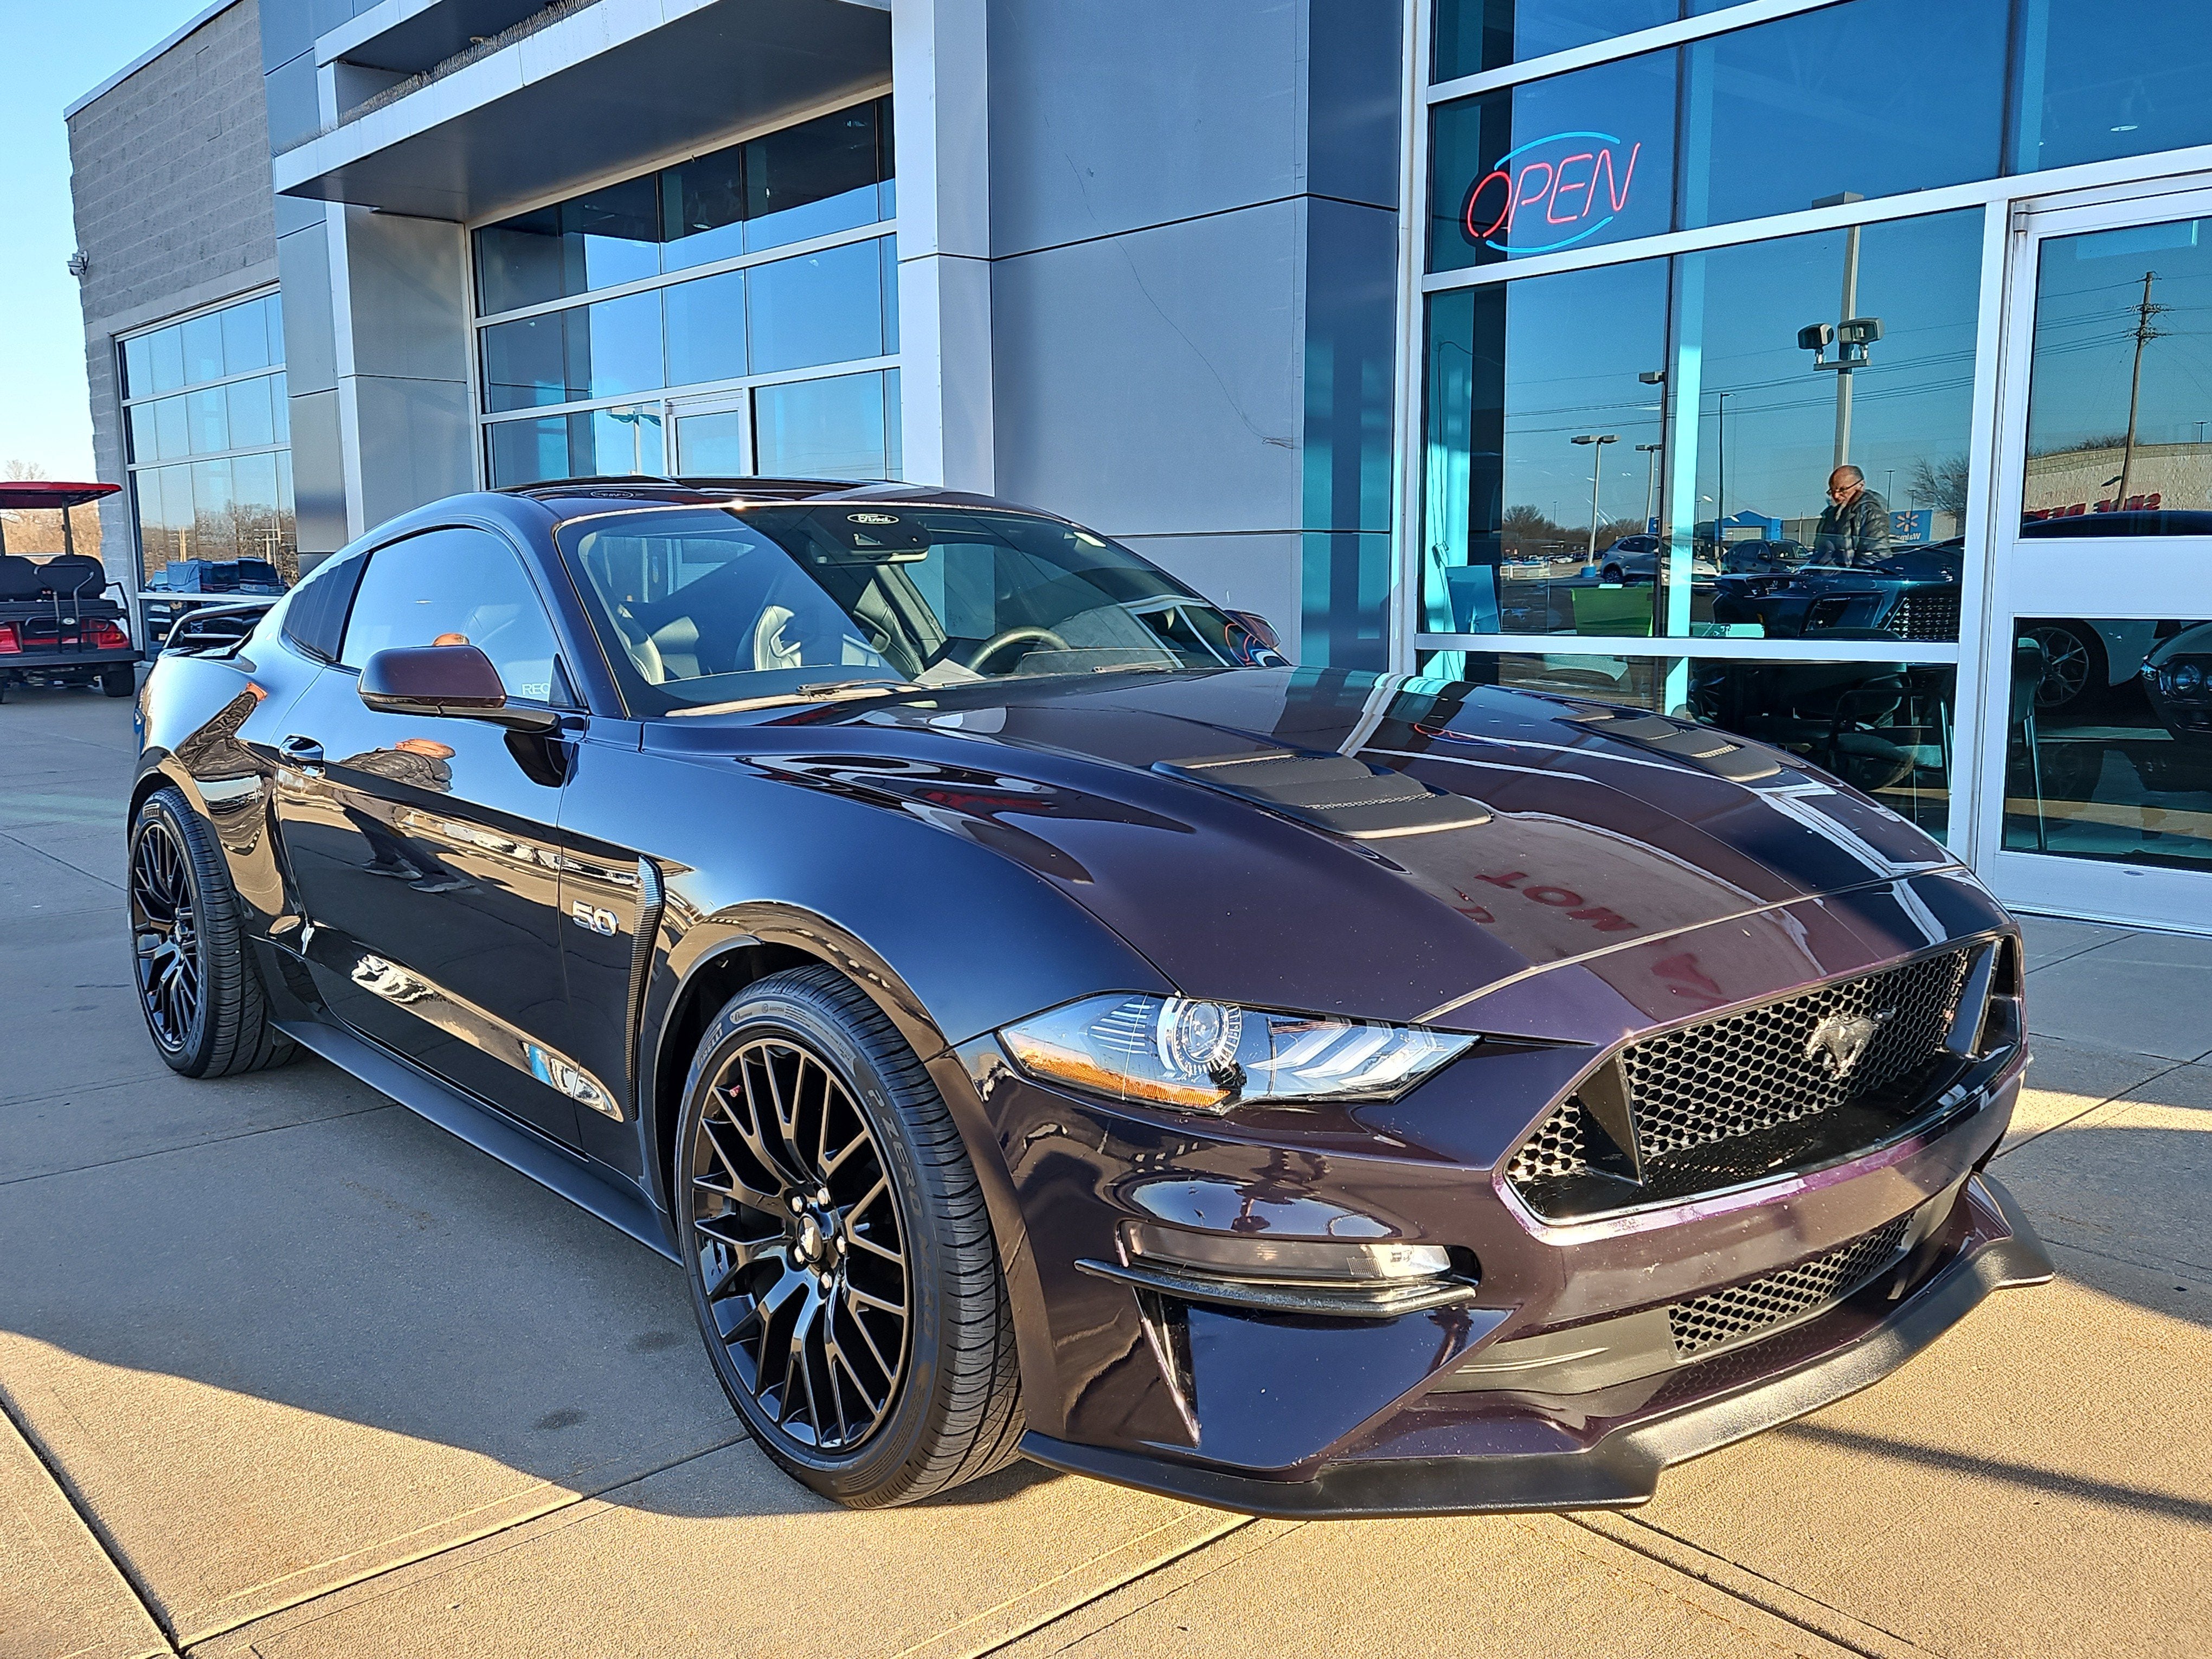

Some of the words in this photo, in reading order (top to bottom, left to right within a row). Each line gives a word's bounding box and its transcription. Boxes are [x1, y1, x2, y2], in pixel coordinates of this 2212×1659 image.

[1467, 142, 1641, 238] OPEN
[858, 513, 891, 524] Ford
[572, 899, 619, 937] 5.0
[867, 1089, 885, 1108] P
[882, 1117, 924, 1219] ZERO
